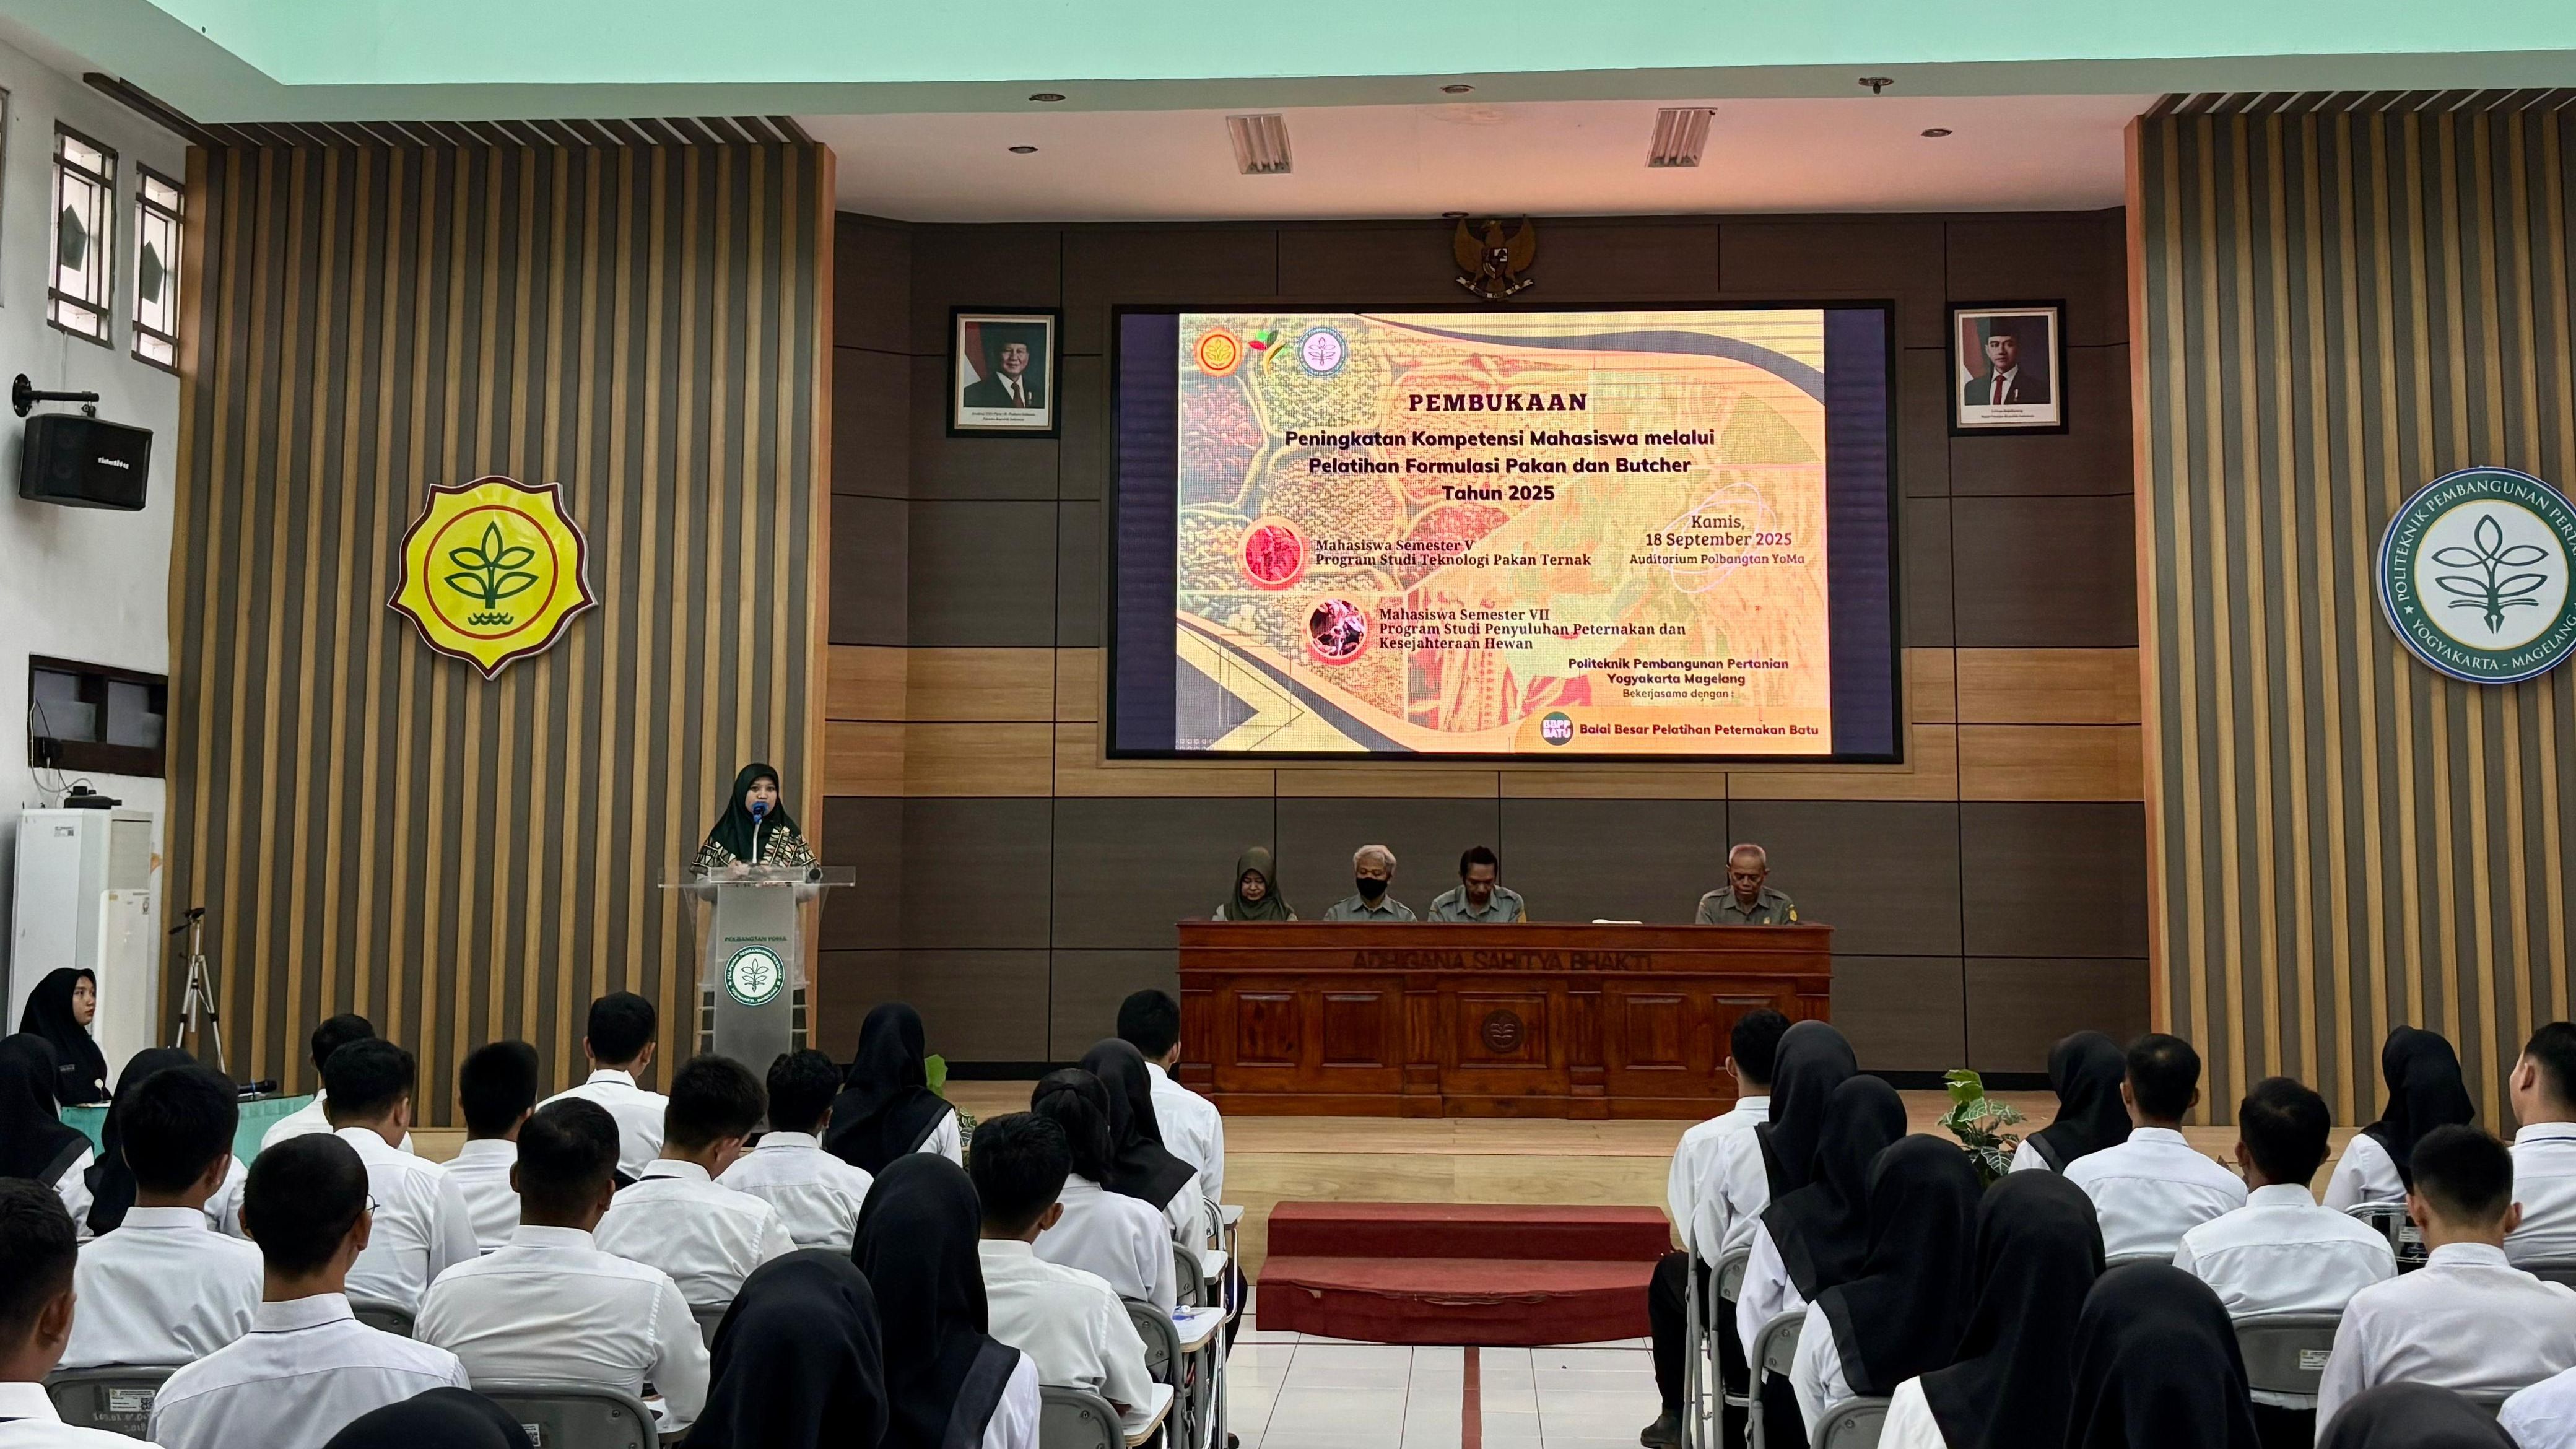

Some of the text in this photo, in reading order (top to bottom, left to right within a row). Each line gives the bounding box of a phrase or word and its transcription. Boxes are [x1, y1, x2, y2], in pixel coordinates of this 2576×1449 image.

[1409, 394, 1586, 411] PEMBUKAAN
[1285, 430, 1715, 450] Peningkatan Kompetensi Mahasiswa melalui
[1309, 458, 1691, 473] Pelatihan Formulasi Pakan dan Butcher
[1443, 485, 1555, 501] Tahun 2025
[1691, 515, 1745, 530] Kamis,
[1316, 540, 1474, 551] Mahasiswa Semester V
[1645, 532, 1792, 549] 18 September 2025
[2394, 507, 2429, 602] POLITEKNIK
[2426, 480, 2549, 512] PEMBANGUNAN
[1316, 554, 1591, 568] Program Studi Teknologi Pakan Ternak
[1630, 554, 1804, 566] Auditorium Polbangtan YoMa
[1380, 609, 1550, 620] Mahasiswa Semester VII
[1380, 623, 1686, 637] Program Studi Penyuluhan Peternakan dan
[1380, 638, 1533, 651] Kesejahteraan Hewan
[2412, 619, 2499, 670] YOGYAKARTA
[2512, 614, 2576, 668] MAGELANG
[1569, 658, 1789, 671] Politeknik Pembangunan Pertanian
[1607, 673, 1745, 686] Yogyakarta Magelang
[1623, 689, 1687, 700] Bekerjasama
[1690, 689, 1728, 699] dengan
[1580, 723, 1818, 734] Balai Besar Pelatihan Peternakan Batu
[1473, 952, 1563, 970] SAHITYA
[1570, 952, 1652, 971] BHAKTI
